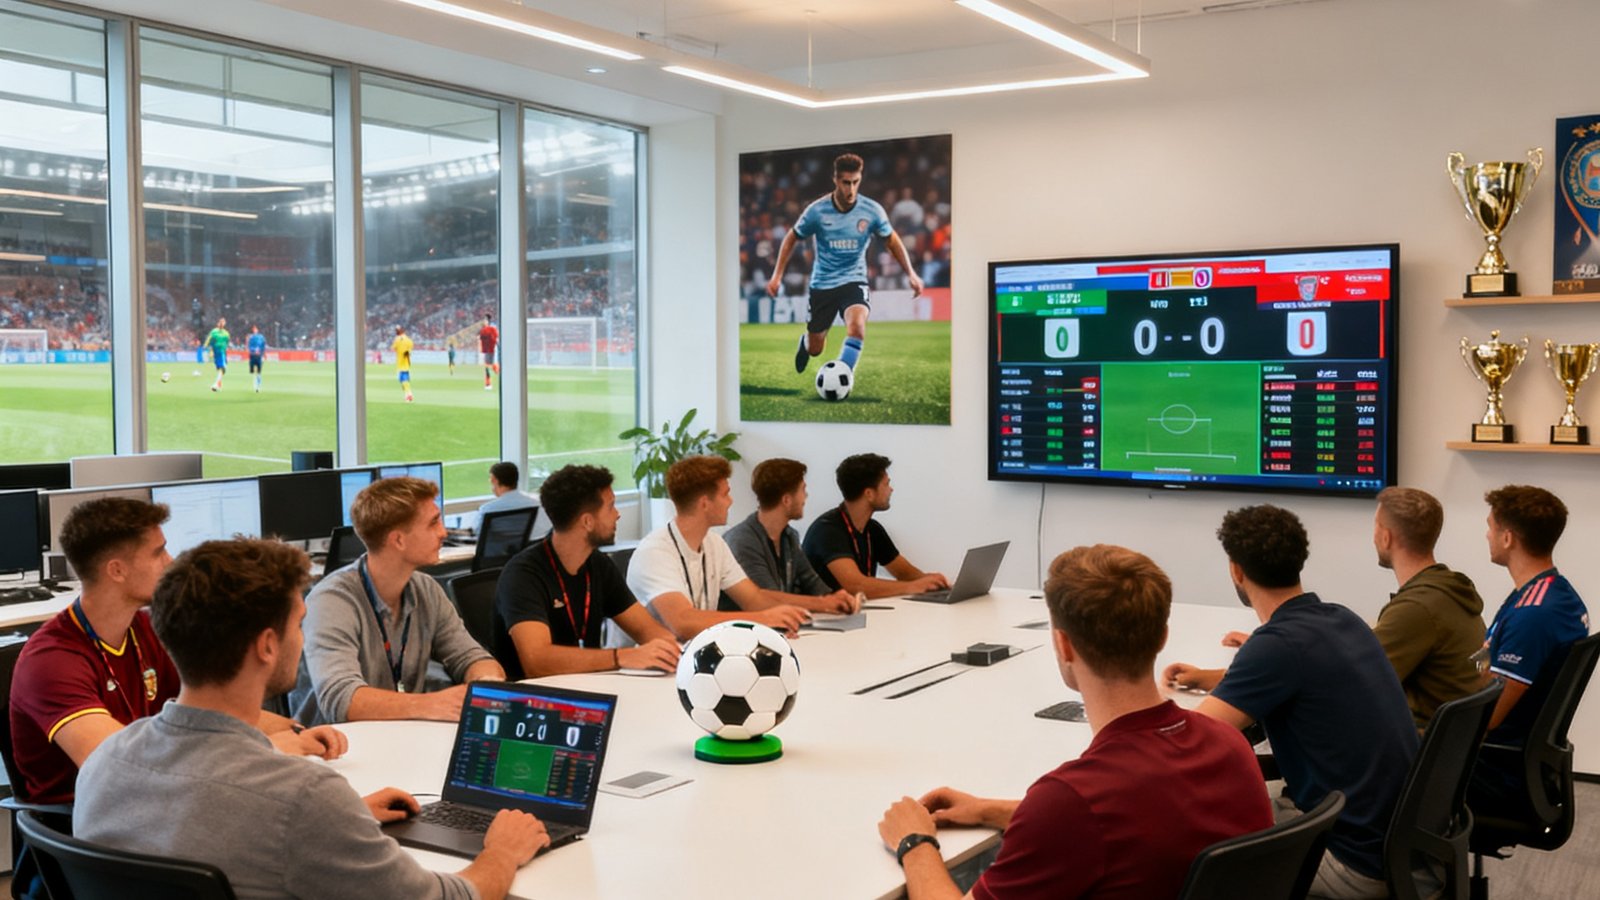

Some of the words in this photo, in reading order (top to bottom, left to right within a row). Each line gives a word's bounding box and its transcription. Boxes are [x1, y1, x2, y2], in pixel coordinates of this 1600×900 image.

[1056, 325, 1069, 352] 0
[1134, 319, 1157, 355] 0
[1200, 317, 1225, 355] 0
[1300, 318, 1315, 349] 0
